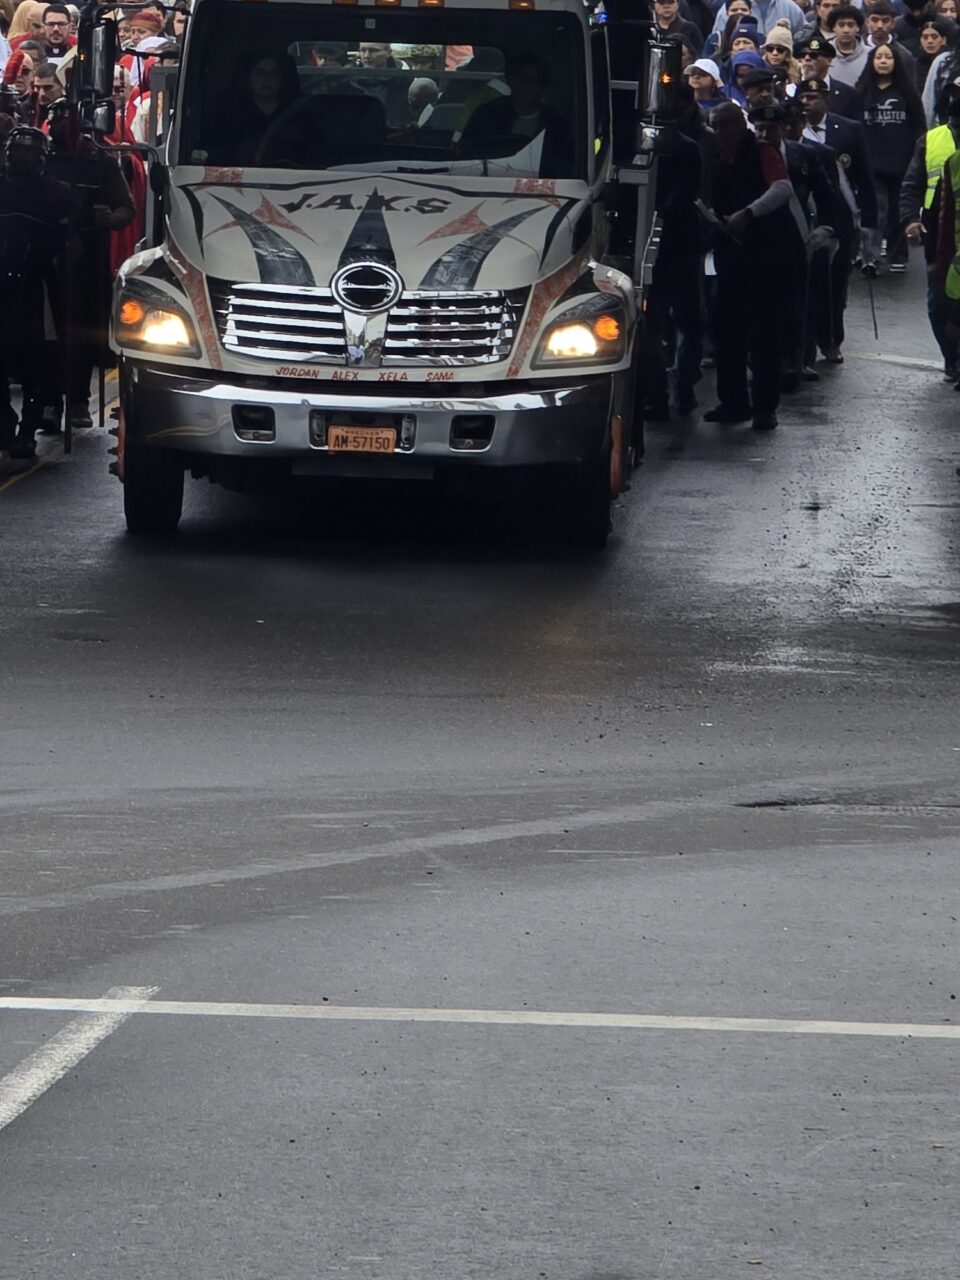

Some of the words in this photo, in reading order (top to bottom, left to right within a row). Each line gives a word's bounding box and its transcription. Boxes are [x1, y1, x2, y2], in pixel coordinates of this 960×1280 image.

[275, 366, 320, 378] JORDAN
[331, 371, 360, 381] ALEX
[378, 371, 409, 382] XELA
